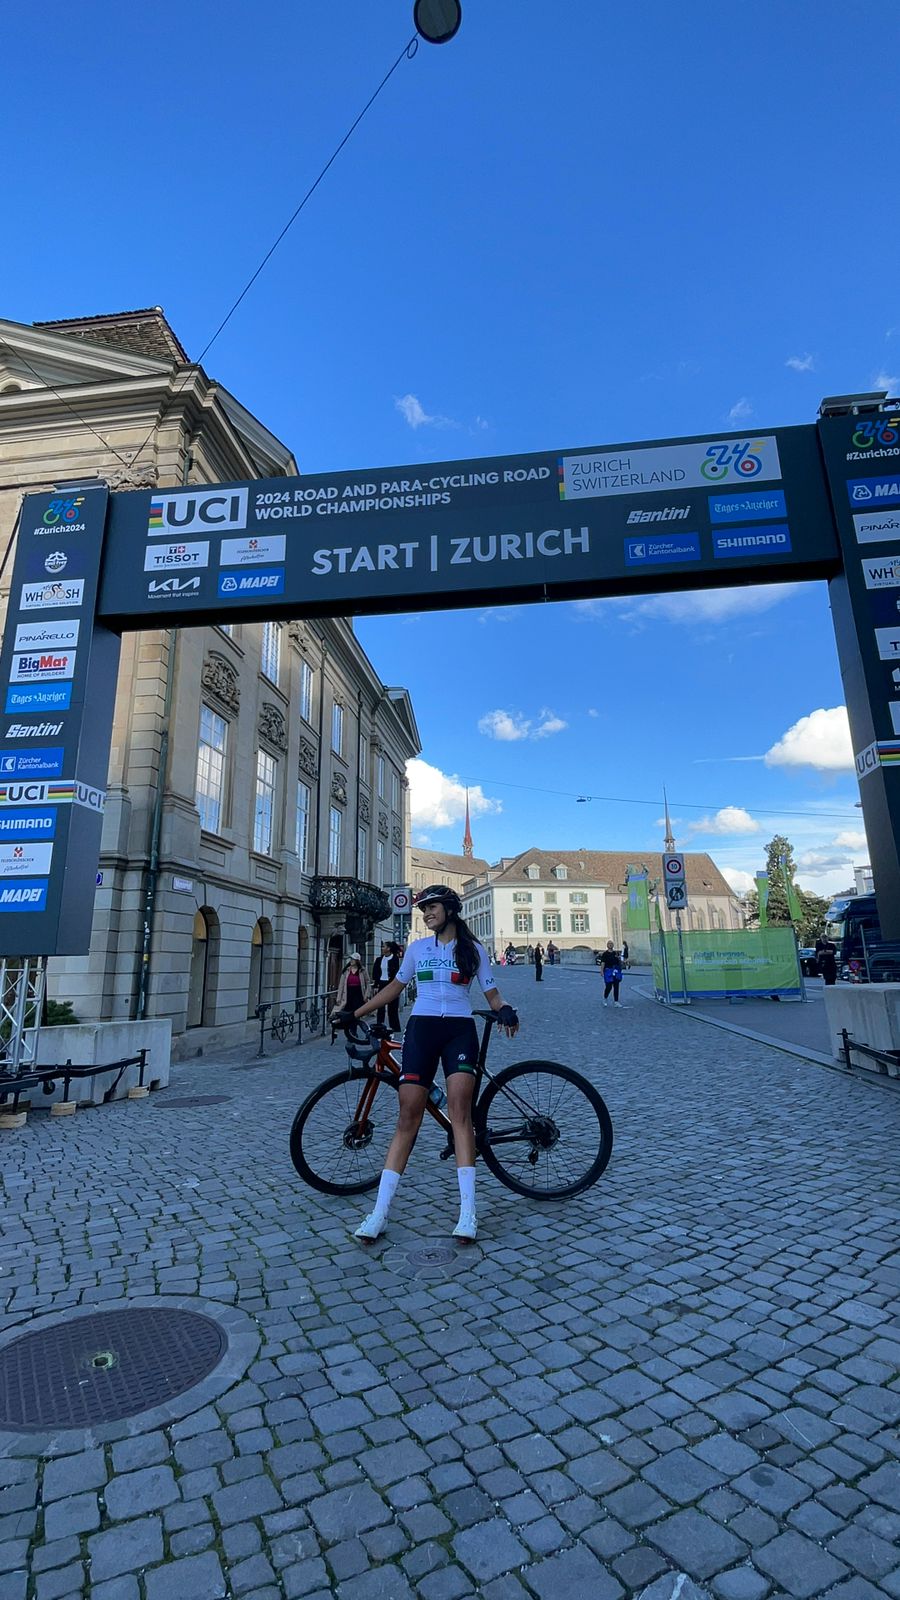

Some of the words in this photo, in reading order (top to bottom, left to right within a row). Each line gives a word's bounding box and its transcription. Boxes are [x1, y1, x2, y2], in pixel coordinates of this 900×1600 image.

[846, 448, 900, 460] #Zurich20
[571, 458, 631, 476] ZURICH
[256, 492, 290, 505] 2024
[294, 487, 338, 502] ROAD
[342, 483, 377, 498] AND
[381, 472, 499, 494] PARA-CYCLING
[504, 467, 550, 482] ROAD
[573, 468, 686, 491] SWITZERLAND
[167, 495, 240, 527] UCI
[255, 505, 312, 520] WORLD
[316, 492, 451, 515] CHAMPIONSHIPS
[626, 505, 691, 524] Santini
[34, 524, 85, 535] #Zurich2024
[717, 533, 786, 548] SHIMANO
[154, 553, 200, 564] TISSOT
[311, 542, 419, 575] START
[450, 526, 590, 564] ZURICH
[648, 546, 696, 556] Kantonalbank
[148, 577, 200, 592] KIA
[239, 576, 281, 589] MAPEI
[19, 632, 75, 642] PINARELLO
[18, 655, 68, 672] BigMat
[5, 721, 64, 738] Santini
[18, 761, 59, 770] Kantonalbank
[857, 748, 876, 774] UCI
[8, 785, 45, 801] UCI
[77, 785, 102, 808] UCI
[0, 818, 52, 830] HIMANO
[0, 888, 43, 903] MAPEI
